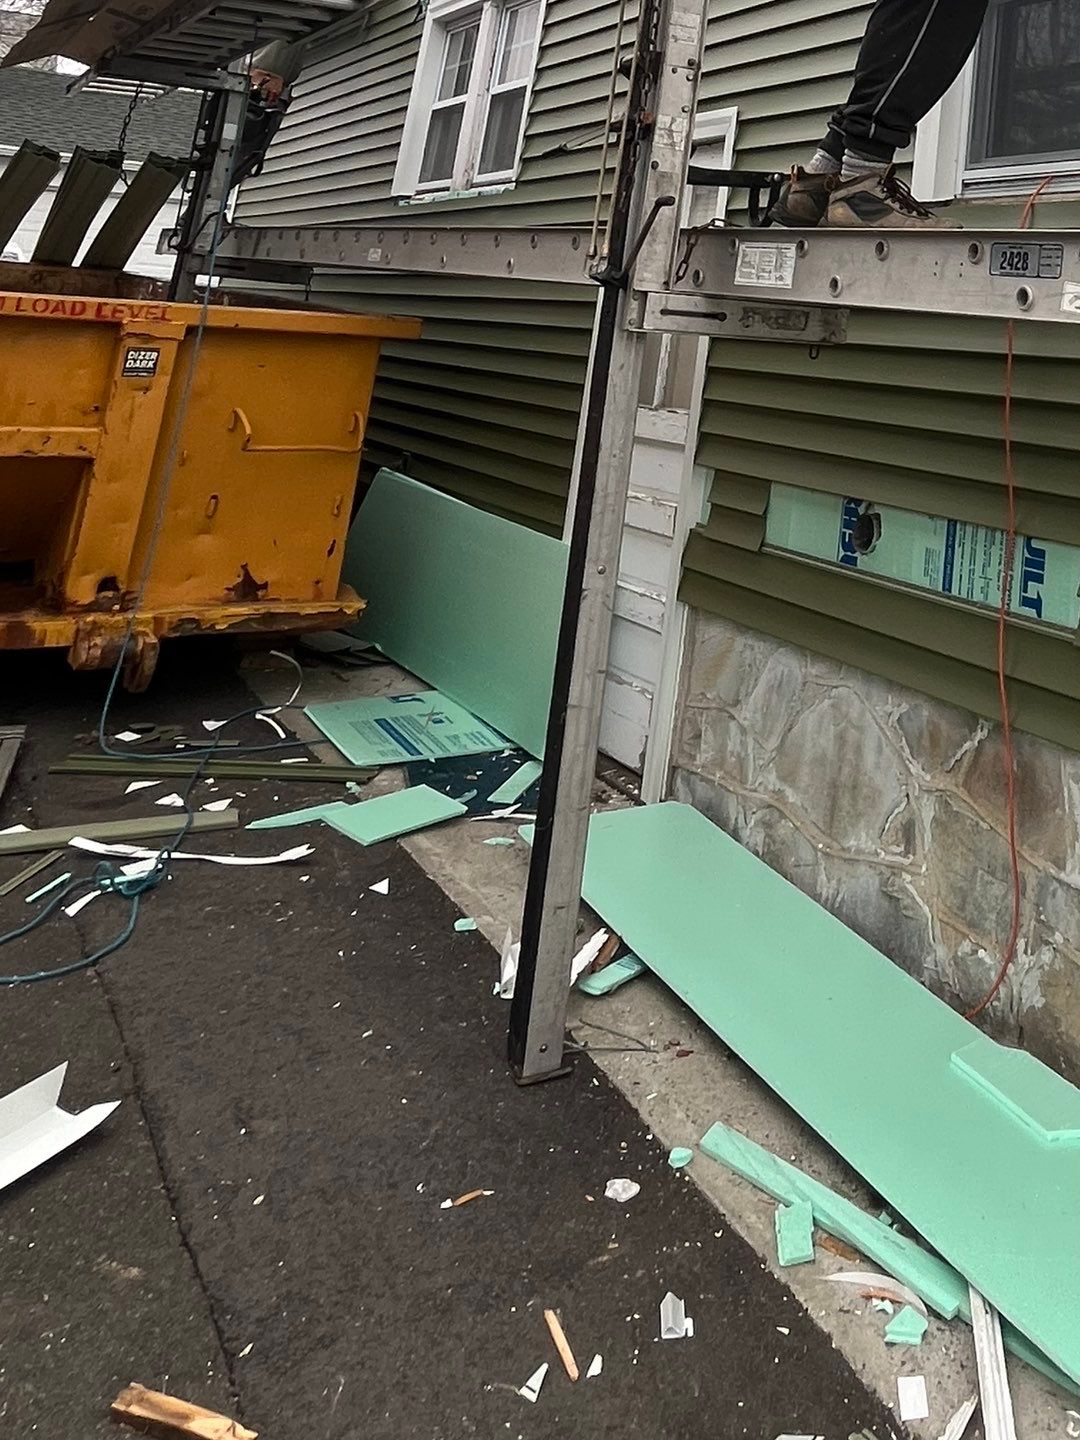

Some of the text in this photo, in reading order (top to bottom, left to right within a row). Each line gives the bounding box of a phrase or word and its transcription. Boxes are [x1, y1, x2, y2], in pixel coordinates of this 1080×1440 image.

[1000, 251, 1029, 271] 2428
[15, 297, 173, 321] LOAD LEVEL
